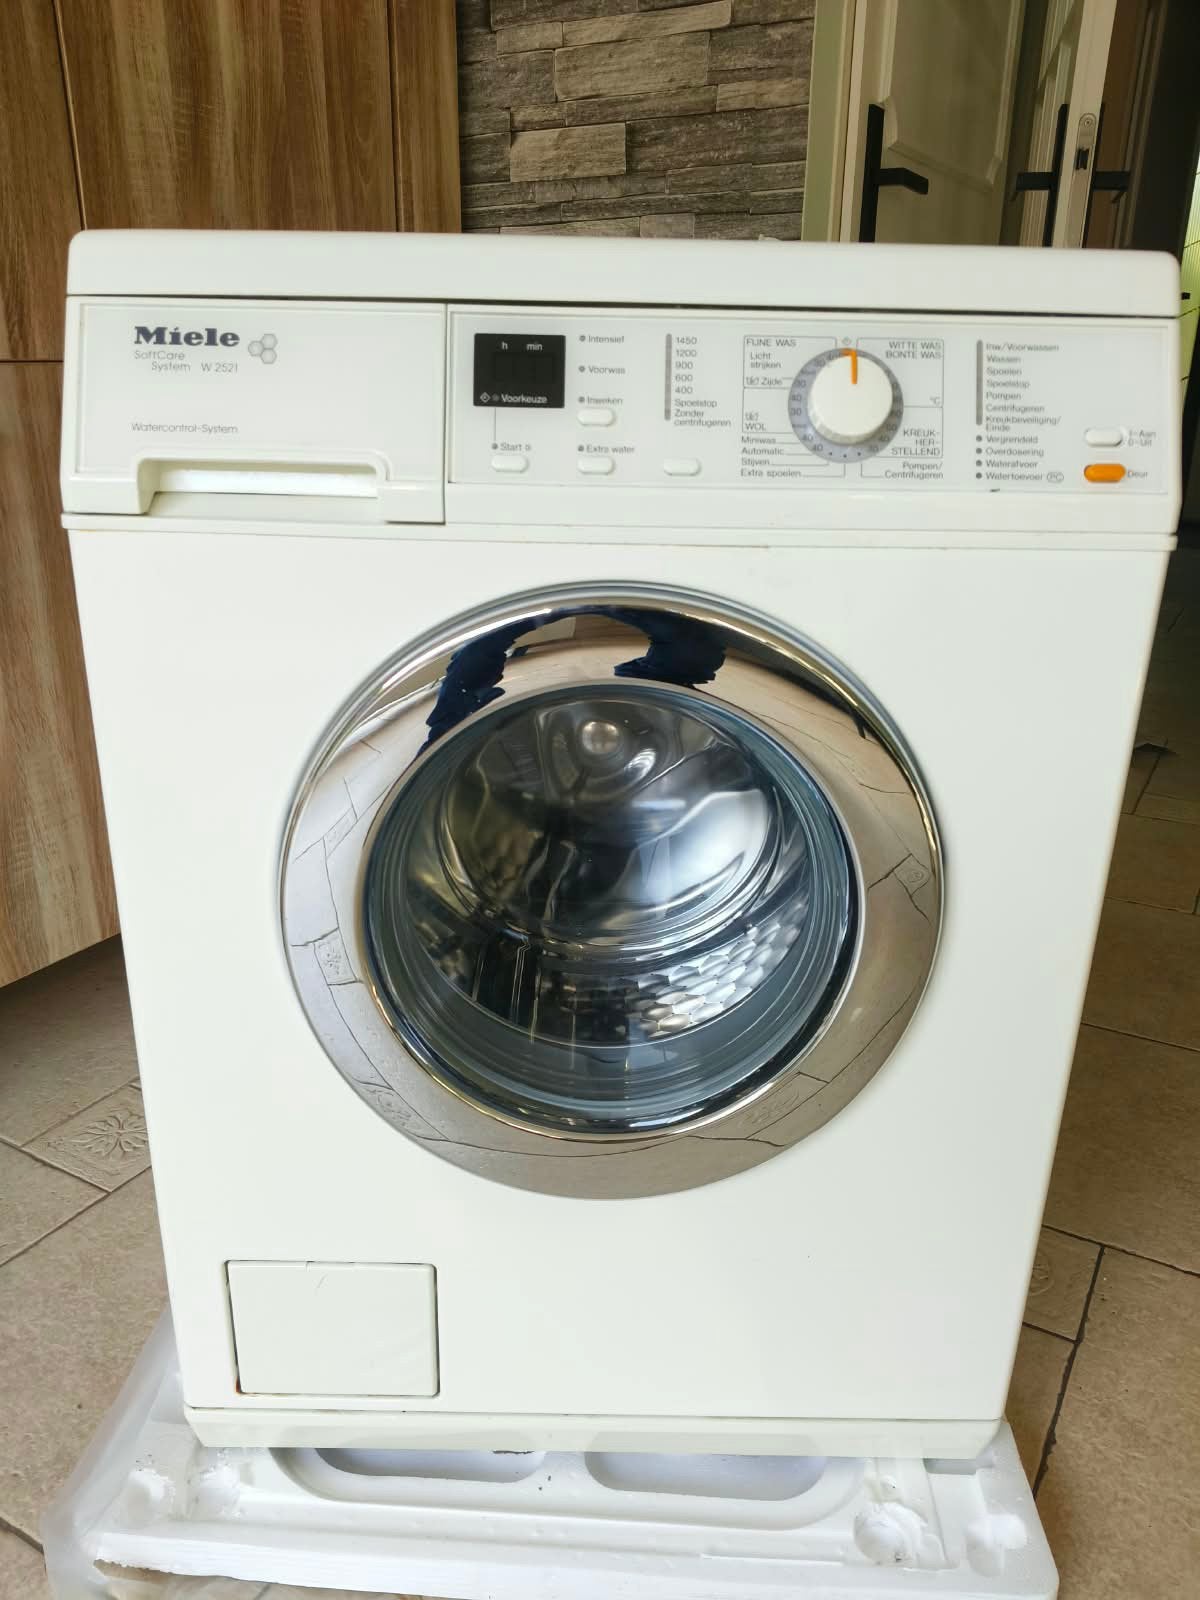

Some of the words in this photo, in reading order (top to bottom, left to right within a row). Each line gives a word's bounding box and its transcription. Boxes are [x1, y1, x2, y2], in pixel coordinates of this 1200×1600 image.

[134, 326, 240, 347] Miele
[588, 335, 625, 344] Intensief
[676, 336, 697, 345] 1450
[502, 342, 508, 350] h
[526, 342, 543, 351] min
[776, 338, 797, 347] WAS
[889, 341, 918, 350] WITTE
[920, 341, 942, 350] WAS
[134, 350, 185, 361] SoftCare
[676, 348, 697, 358] 1200
[750, 351, 771, 360] Licht
[885, 351, 918, 359] BONTE
[921, 351, 942, 360] WAS
[986, 355, 1022, 363] Wassen
[151, 361, 191, 373] System
[201, 363, 212, 373] W
[215, 363, 238, 373] 2521
[588, 365, 626, 374] Voorwas
[675, 361, 693, 370] 900
[986, 367, 1022, 376] Spoelen
[675, 373, 693, 382] 600
[986, 379, 1031, 388] Spoelstop
[675, 386, 693, 394] 400
[501, 393, 548, 404] Voorkeuze
[986, 391, 1022, 400] Pompen
[587, 396, 624, 405] Inweken
[674, 398, 718, 408] Spoelstop
[986, 403, 1045, 413] Centrifugeren
[674, 409, 704, 417] Zonder
[674, 418, 731, 428] centrifugeren
[745, 422, 766, 431] WOL
[132, 422, 239, 435] Watercontrol-System
[985, 424, 1011, 432] Einde
[741, 436, 776, 444] Miniwas
[986, 435, 1039, 445] Vergrendeld
[500, 442, 522, 452] Start
[586, 444, 609, 453] Extra
[612, 445, 635, 454] water
[741, 446, 785, 455] Automatic
[891, 447, 941, 456] STELLEND
[986, 447, 1045, 457] Overdosering
[741, 457, 770, 466] Stijven
[986, 459, 1038, 468] Waterafvoer
[741, 468, 764, 477] Extra
[766, 469, 801, 478] spoelen
[885, 470, 944, 480] Centrifugeren
[986, 472, 1043, 481] Watertoevoer
[1128, 469, 1148, 478] Deur
